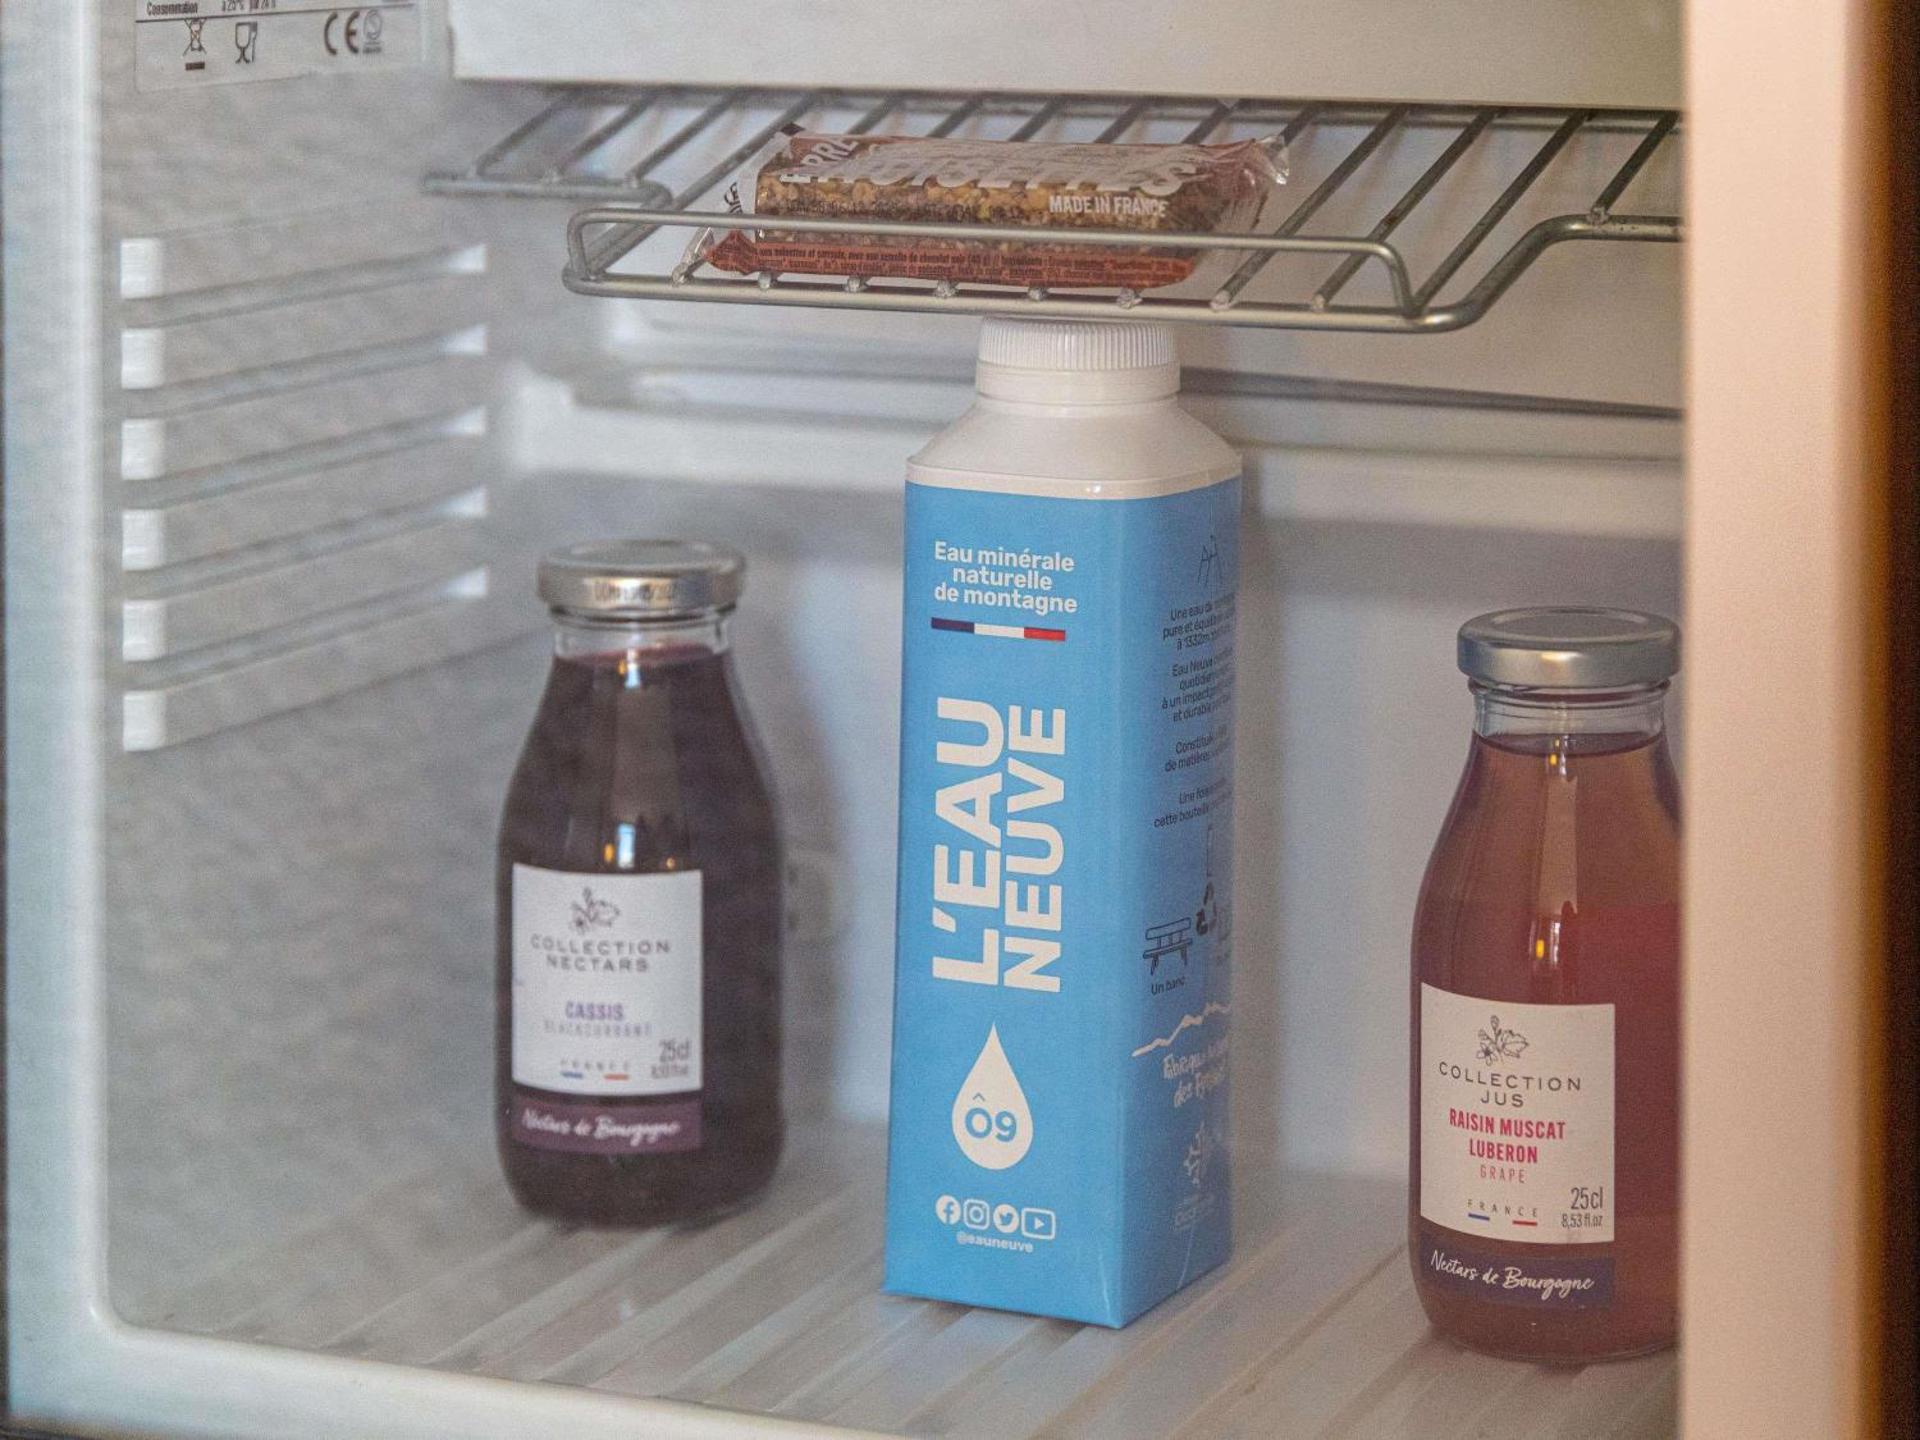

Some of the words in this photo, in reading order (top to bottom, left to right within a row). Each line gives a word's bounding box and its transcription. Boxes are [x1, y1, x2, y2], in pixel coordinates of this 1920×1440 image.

[1050, 196, 1092, 213] MADE
[1095, 197, 1110, 213] IN
[1114, 197, 1169, 217] FRANCE
[934, 541, 973, 563] Eau
[977, 548, 1075, 572] minérale
[953, 566, 1053, 591] naturelle
[934, 583, 961, 602] de
[963, 587, 1079, 615] montagne
[932, 697, 1004, 986] L'EAU
[1003, 705, 1066, 992] NEUVE
[530, 934, 671, 955] COLLECTION
[546, 955, 650, 973] NECTARS
[1151, 983, 1165, 996] Un
[565, 1001, 625, 1021] CASSIS
[1438, 1061, 1582, 1092] COLLECTION
[1480, 1092, 1524, 1108] JUS
[1449, 1108, 1495, 1135] RAISIN
[1500, 1118, 1566, 1141] MUSCAT
[1469, 1138, 1538, 1164] LUBERON
[1480, 1164, 1525, 1184] GRAPE
[1467, 1198, 1539, 1218] FRANCE
[1570, 1186, 1604, 1211] 25cl
[1561, 1212, 1583, 1230] 8,53
[956, 1230, 1034, 1253] @eauneuve
[1430, 1249, 1479, 1282] Nectars
[1482, 1267, 1499, 1286] de
[1502, 1266, 1596, 1301] Bourgogne
